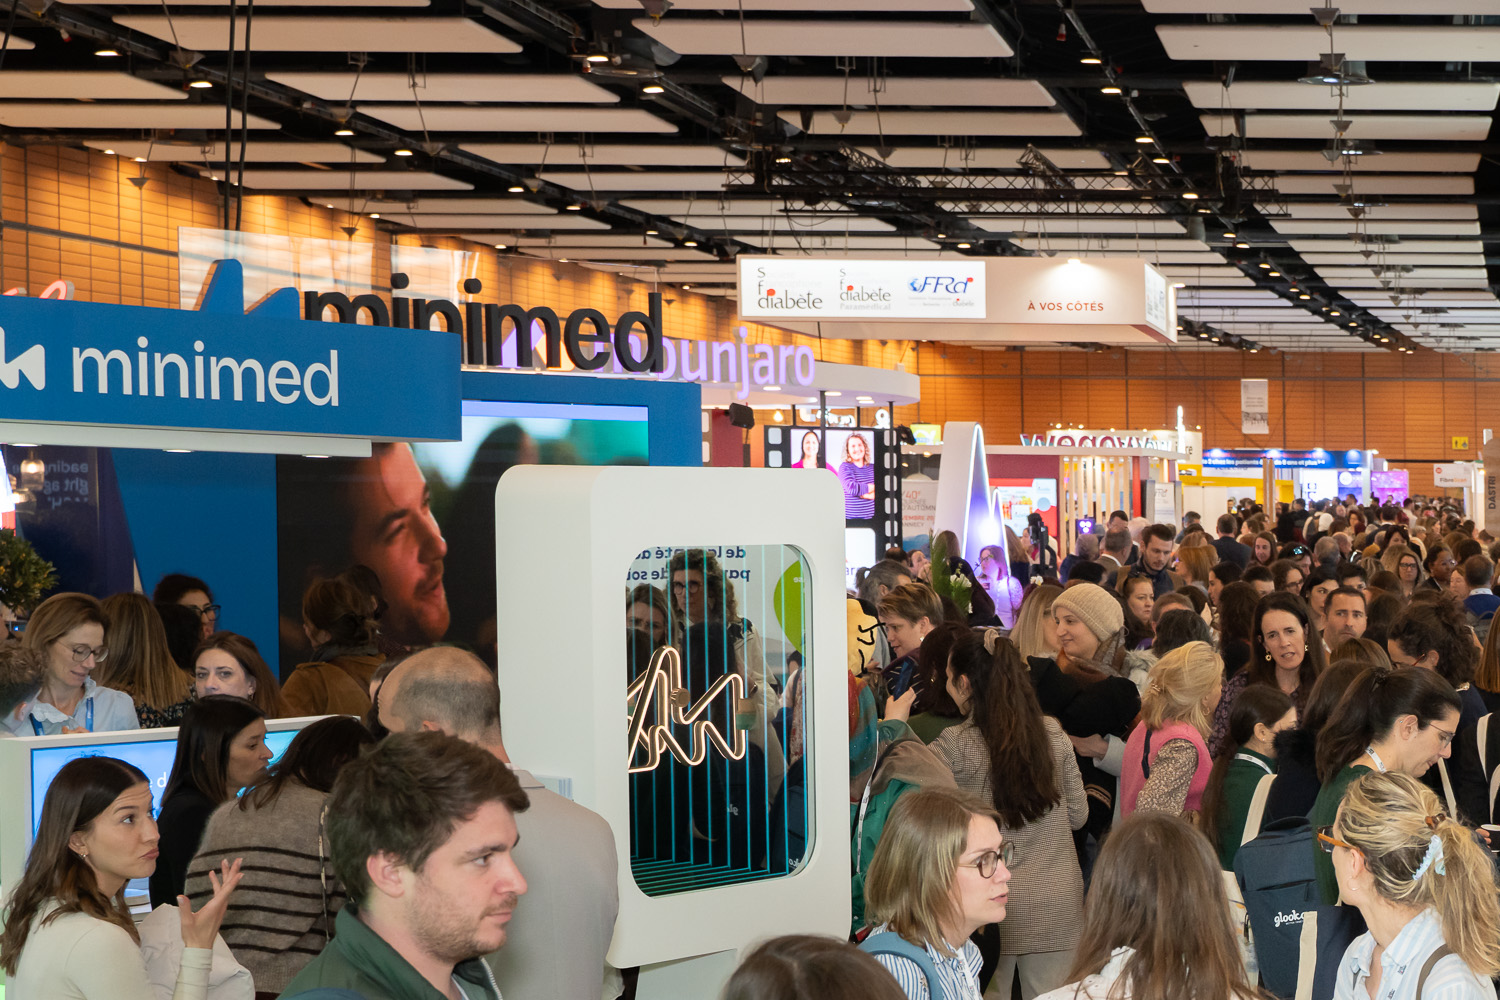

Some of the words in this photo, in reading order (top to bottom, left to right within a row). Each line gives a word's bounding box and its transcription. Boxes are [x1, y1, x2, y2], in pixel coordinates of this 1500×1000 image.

[757, 287, 823, 309] diabète
[839, 284, 892, 302] diabète
[1027, 300, 1036, 311] À
[1039, 302, 1063, 311] VOS
[1066, 300, 1104, 311] CÔTÉS
[72, 336, 339, 406] minimed
[1488, 475, 1497, 510] DASTRI
